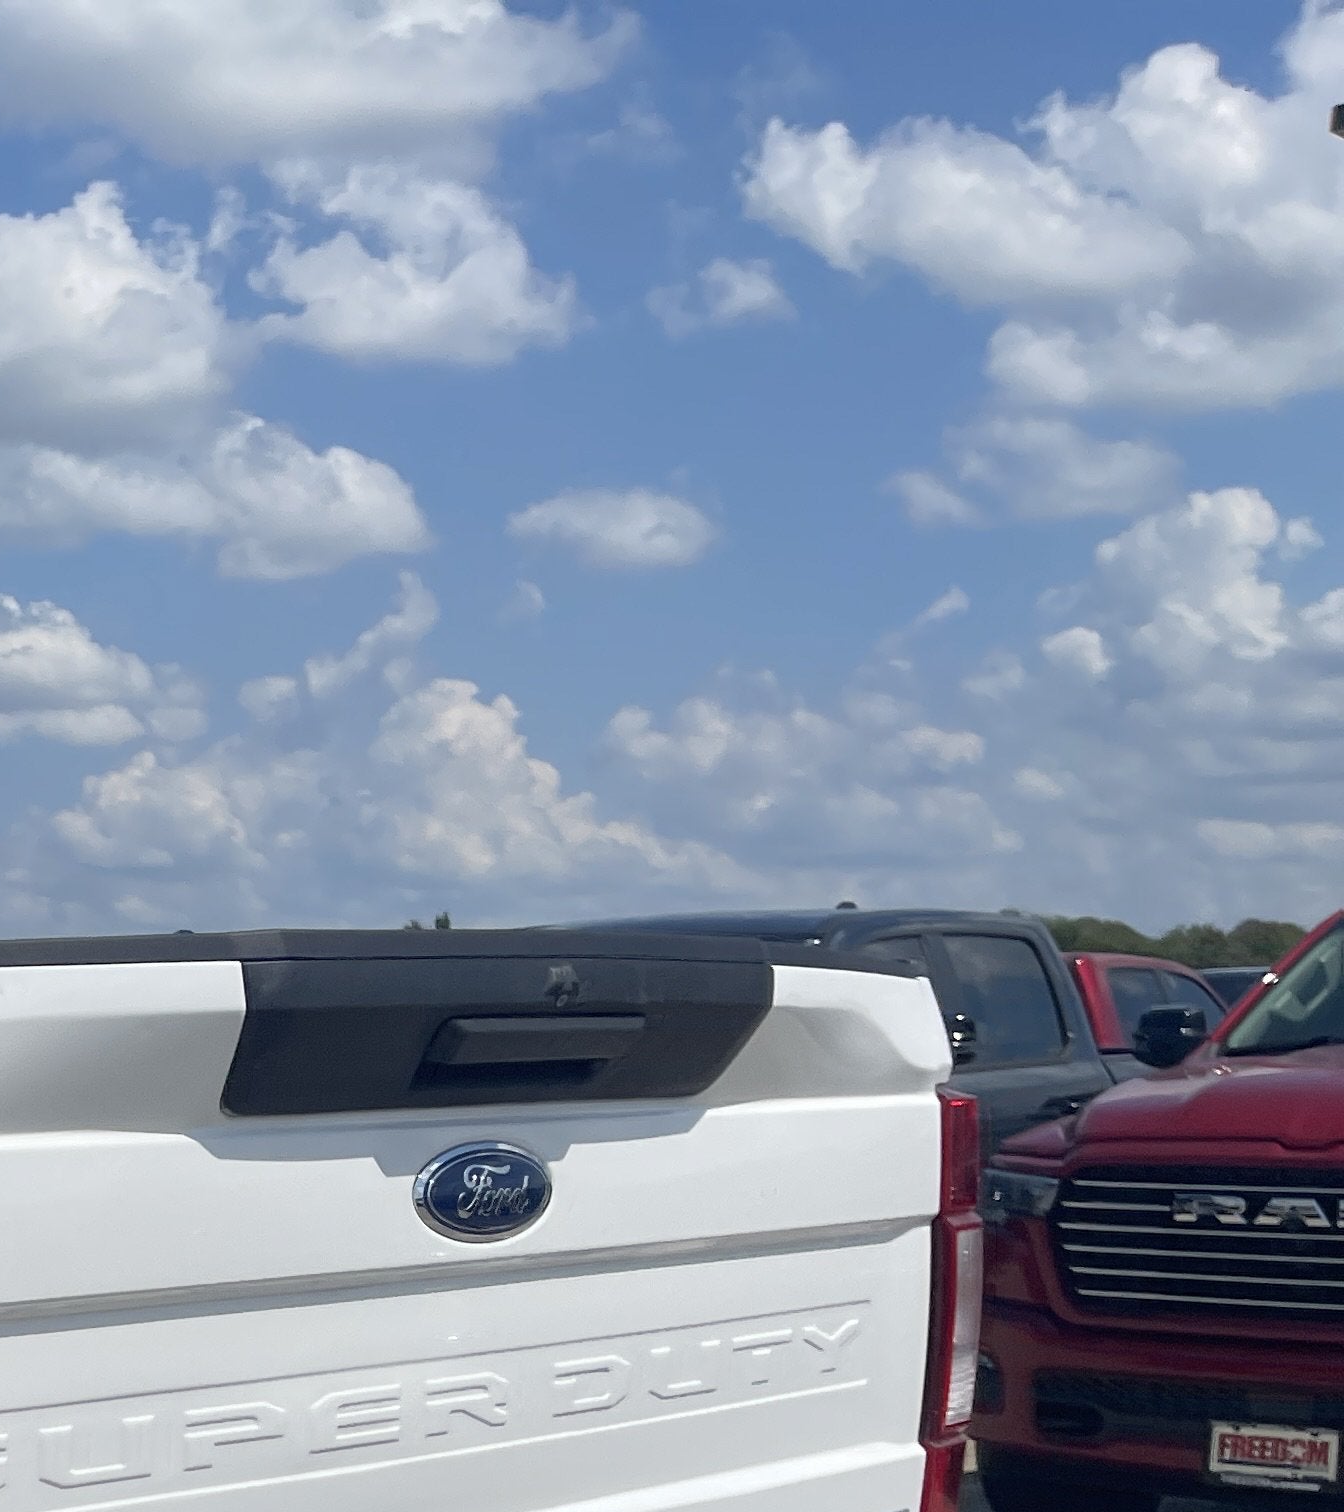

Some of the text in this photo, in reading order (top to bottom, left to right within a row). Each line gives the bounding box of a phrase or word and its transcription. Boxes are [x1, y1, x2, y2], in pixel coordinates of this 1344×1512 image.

[457, 1164, 529, 1219] Ford
[1173, 1192, 1343, 1230] RA
[552, 1318, 860, 1419] DUTY
[1217, 1433, 1329, 1467] FREEDOM
